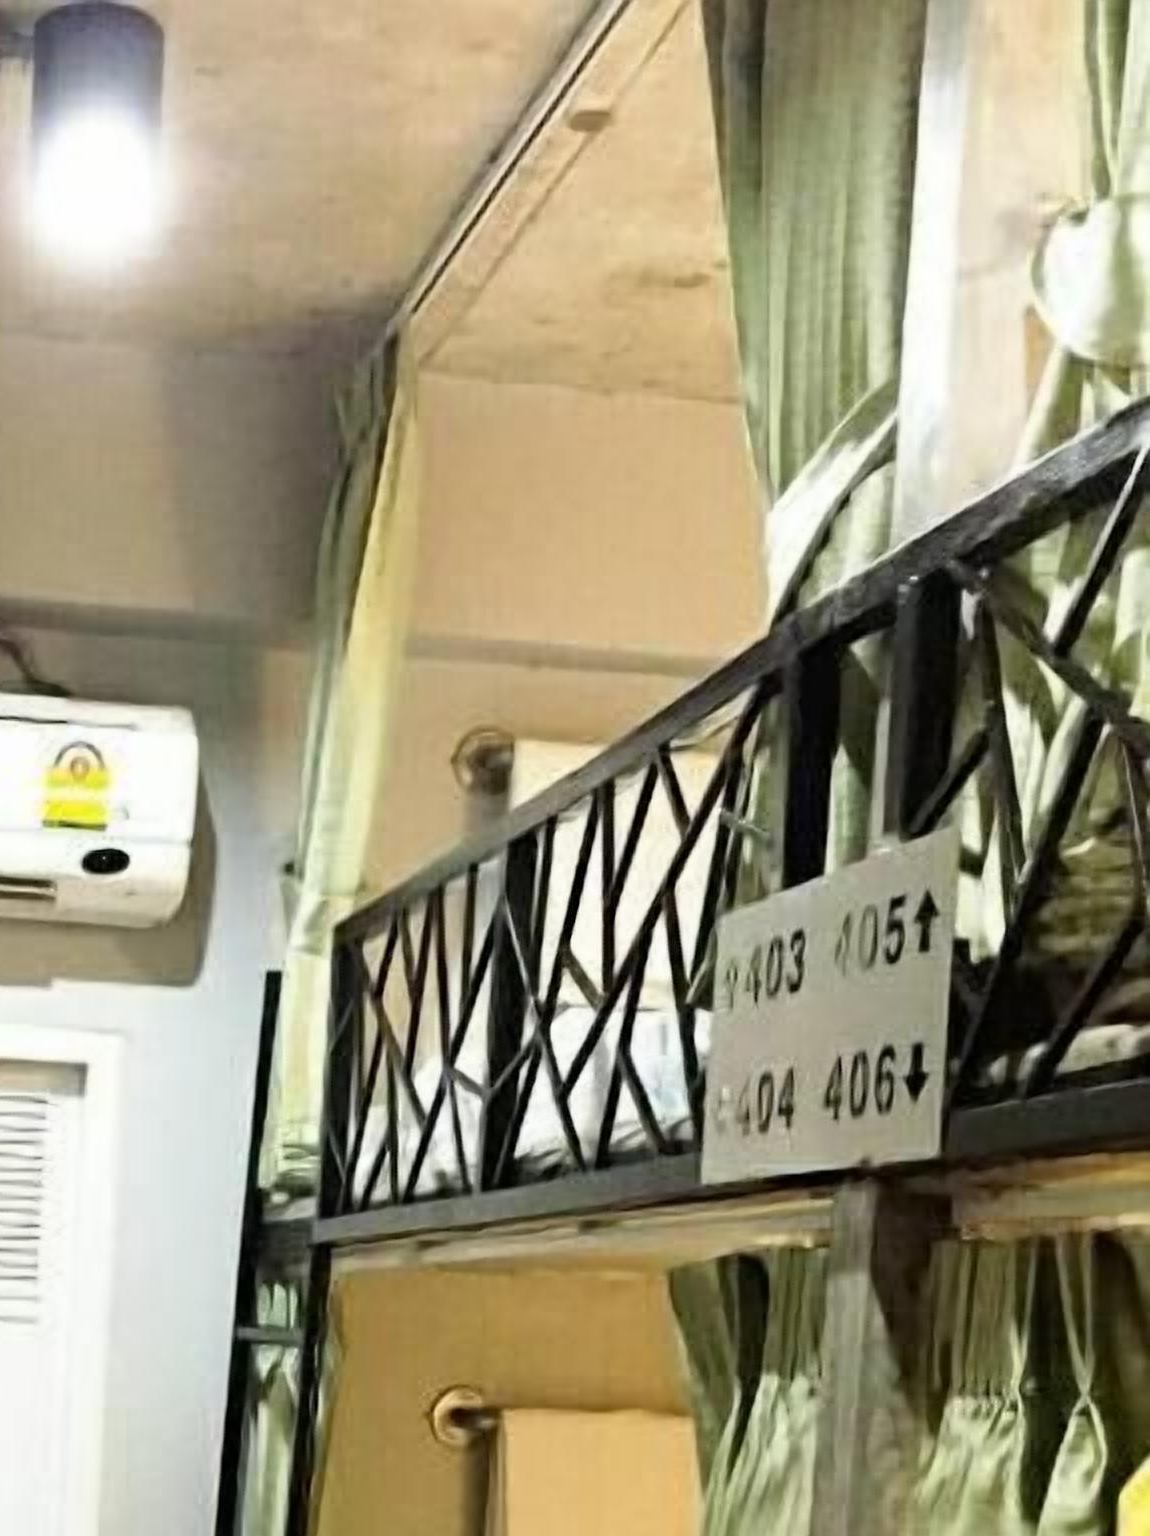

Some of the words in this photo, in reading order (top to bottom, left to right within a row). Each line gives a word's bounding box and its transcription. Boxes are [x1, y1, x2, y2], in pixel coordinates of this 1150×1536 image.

[746, 928, 806, 1007] 403
[835, 895, 907, 976] 405
[738, 1066, 795, 1136] 404
[824, 1045, 897, 1123] 406
